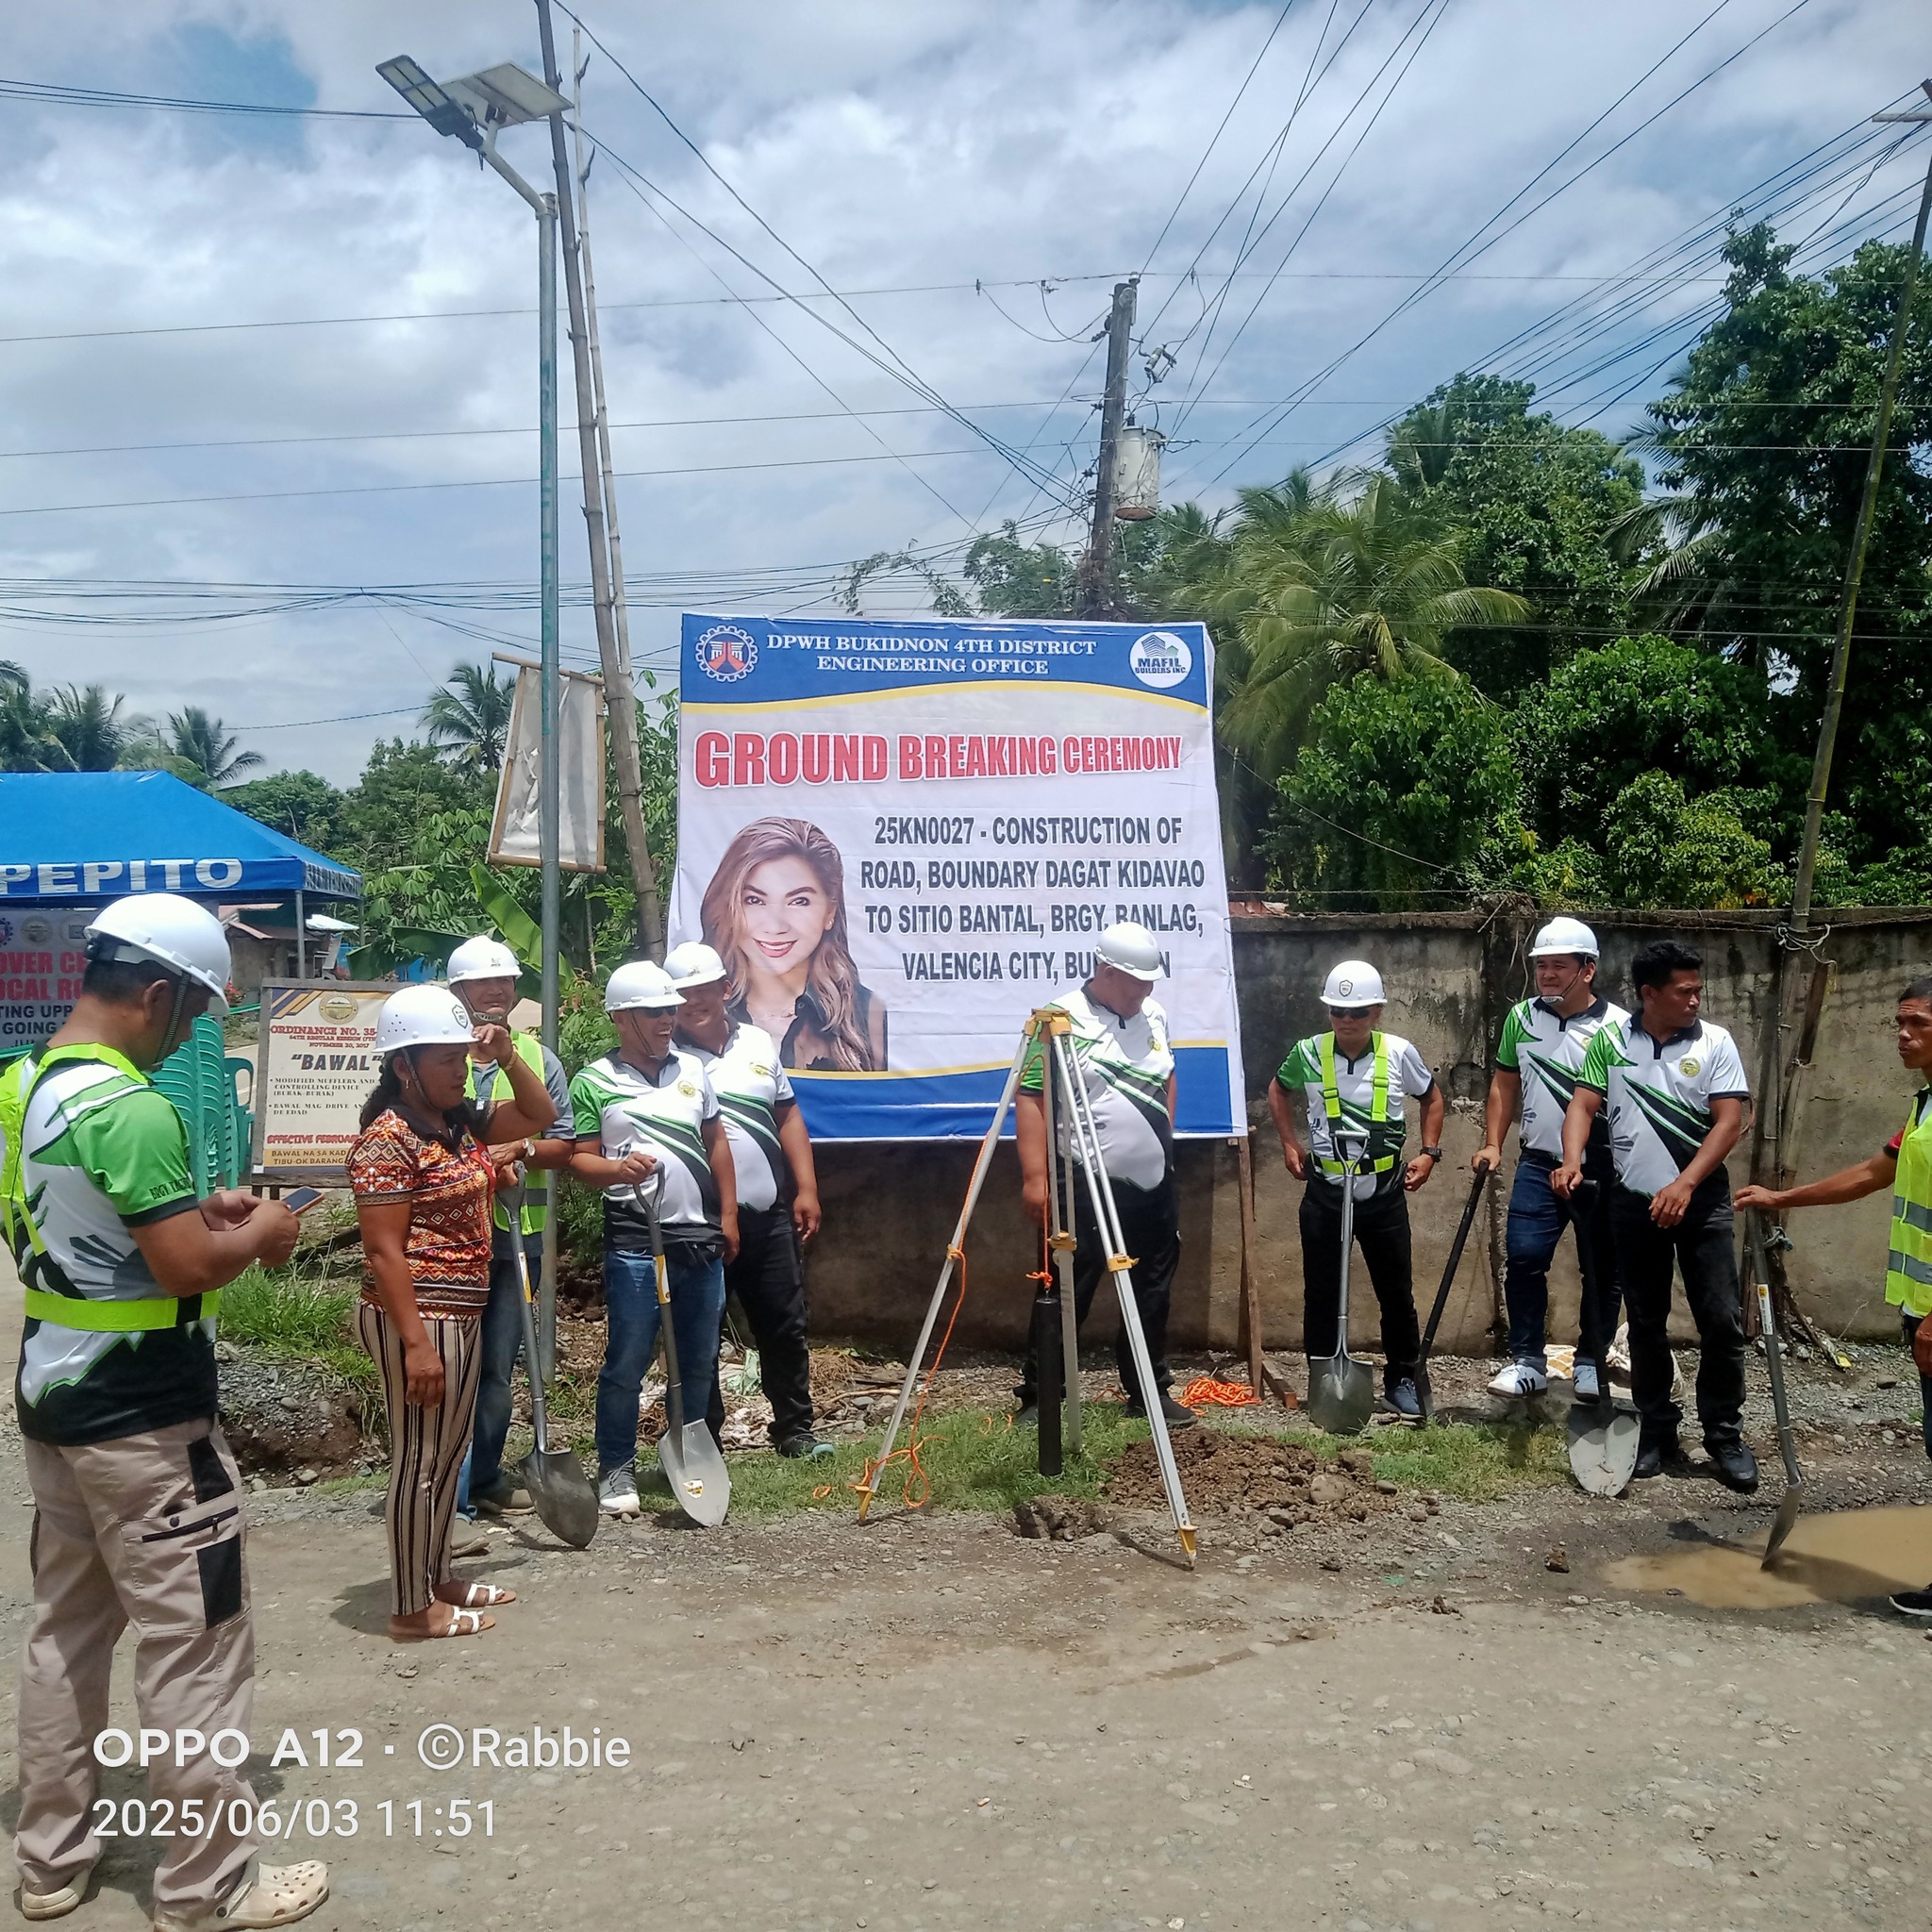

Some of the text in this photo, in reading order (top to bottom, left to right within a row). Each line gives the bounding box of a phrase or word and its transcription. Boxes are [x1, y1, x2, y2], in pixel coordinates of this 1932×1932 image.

[766, 635, 1097, 656] DPWH BUKIDNON 4TH DISTRICT
[816, 656, 1049, 675] ENGINEERING OFFICE
[1137, 658, 1182, 667] MAFIL
[694, 730, 1182, 789] GROUND BREAKING CEREMONY
[874, 816, 975, 845] 25KN0027
[992, 816, 1151, 845] CONSTRUCTION
[1157, 816, 1183, 845] OF
[0, 858, 242, 895] PEPITO
[860, 859, 1206, 896] ROAD, BOUNDARY DAGAT KIDAVAO
[864, 905, 892, 934] TO
[898, 904, 953, 934] SITIO
[958, 904, 1045, 940] BANTAL,
[901, 951, 1004, 981] VALENCIA
[1008, 951, 1058, 986] CITY,
[2, 1022, 57, 1035] GOING
[270, 1025, 337, 1036] ORDINANCE
[340, 1027, 360, 1036] NO.
[266, 1134, 358, 1144] EFFECTIVE FEBRUAR
